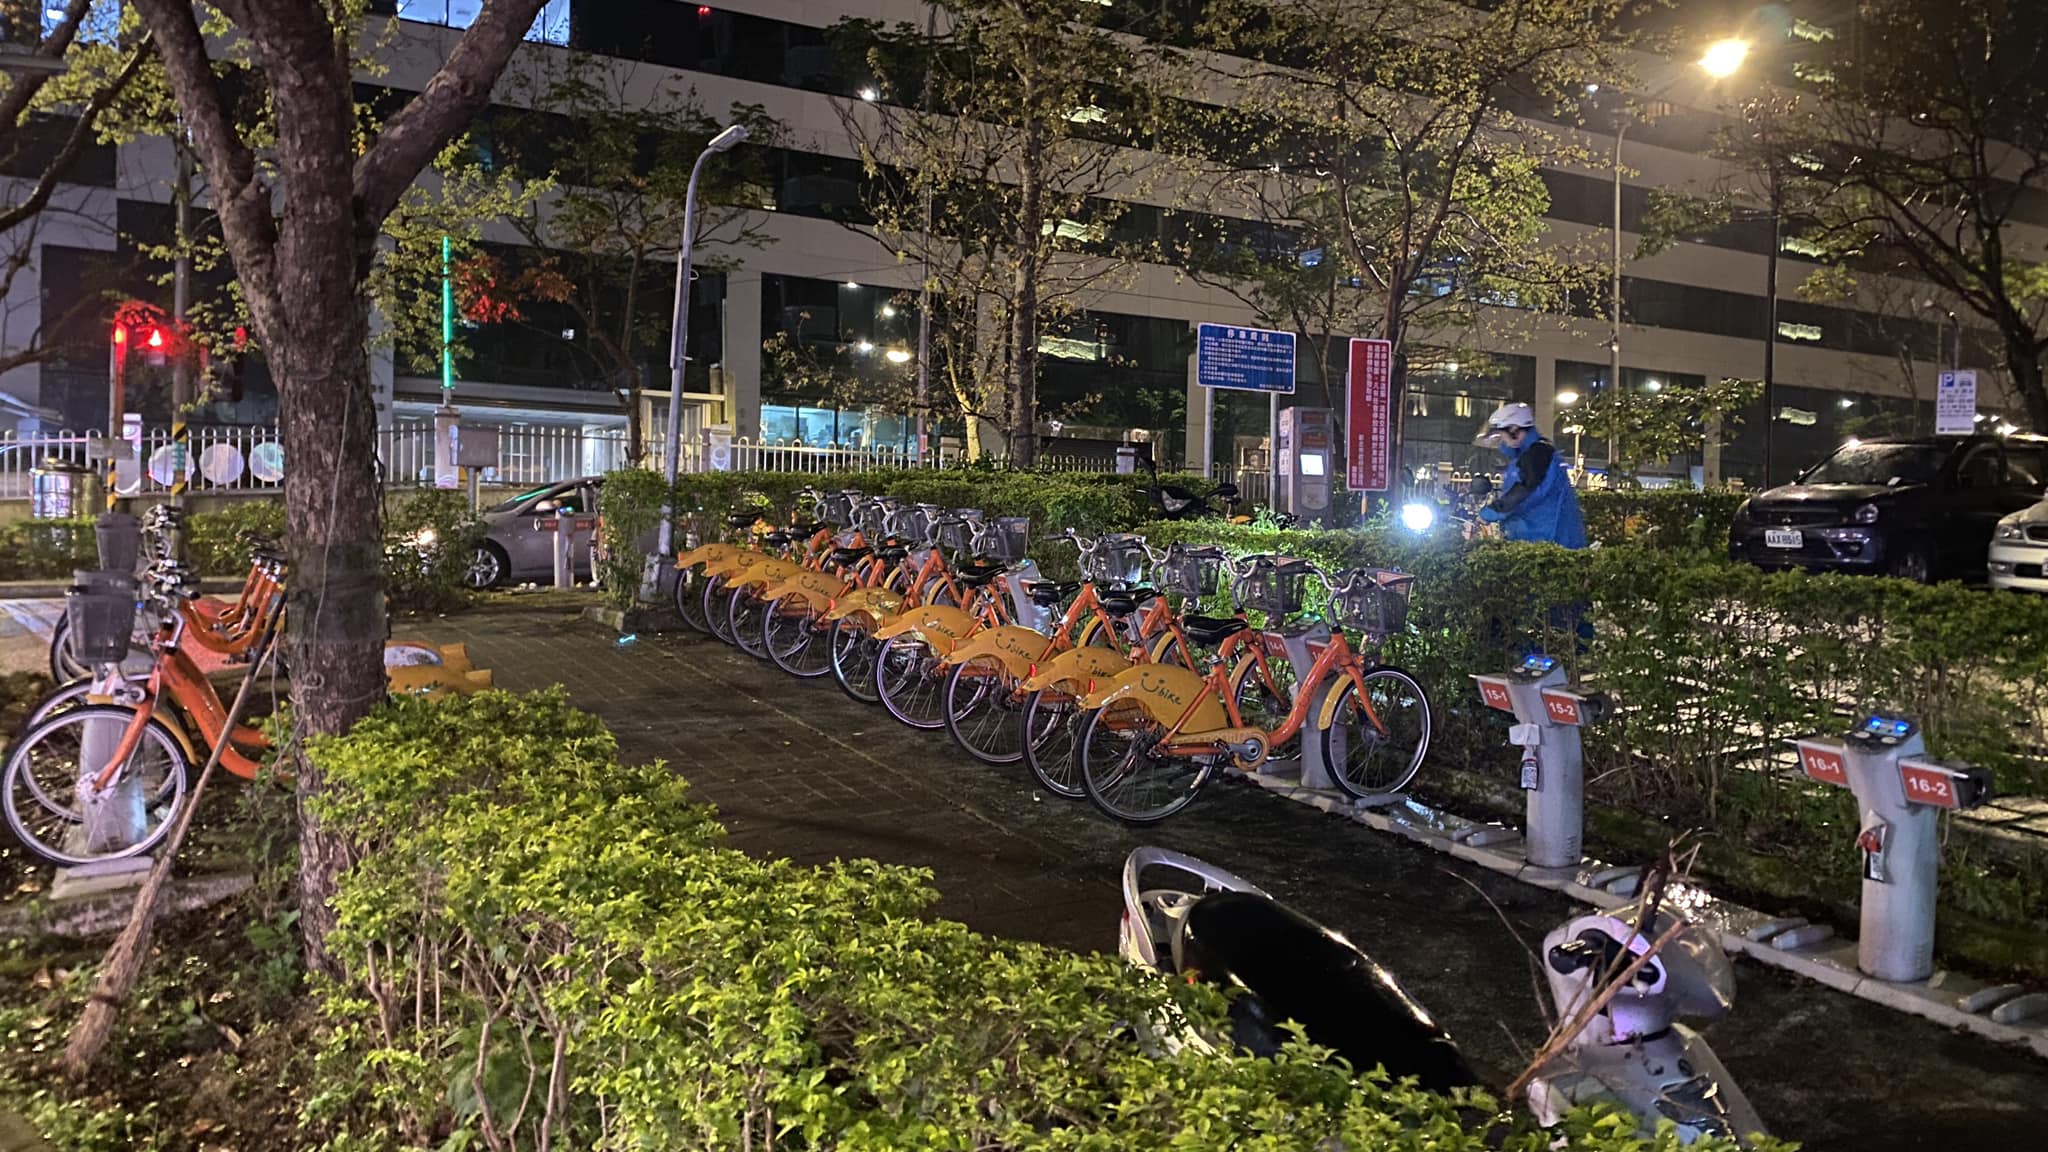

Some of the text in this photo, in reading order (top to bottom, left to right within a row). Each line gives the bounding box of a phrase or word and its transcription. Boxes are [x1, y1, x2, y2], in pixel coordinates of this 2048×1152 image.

[1485, 688, 1508, 702] 15-1
[1549, 702, 1576, 716] 15-2
[1808, 756, 1840, 774] 16-1
[1908, 777, 1949, 797] 16-2
